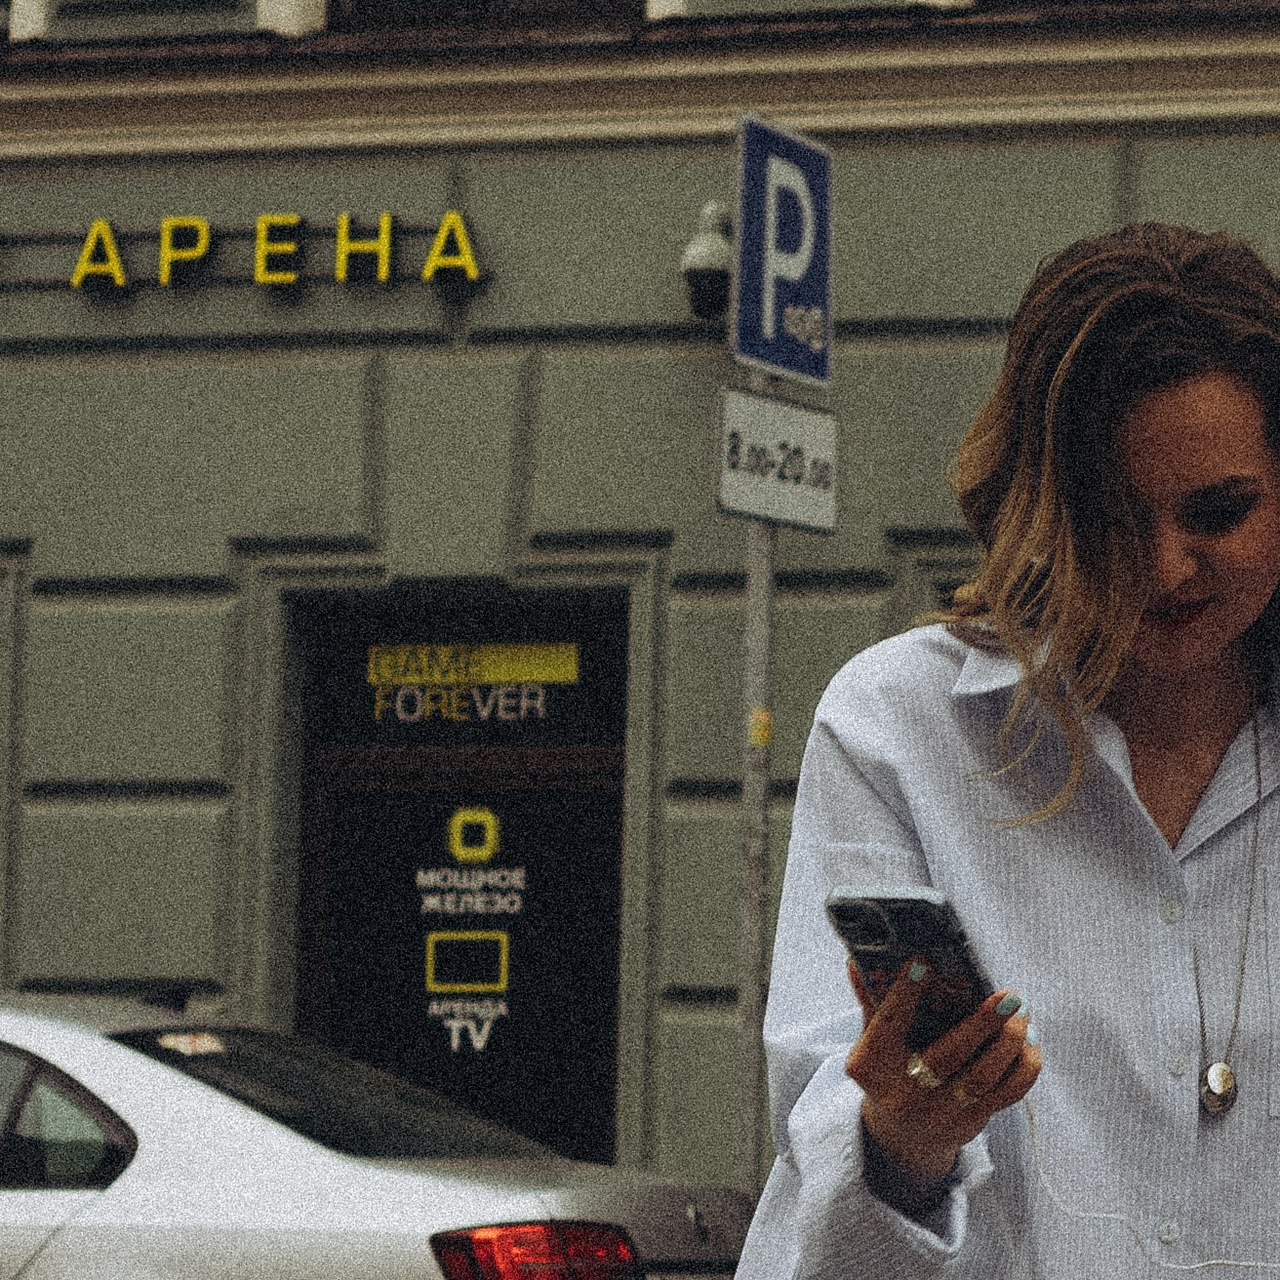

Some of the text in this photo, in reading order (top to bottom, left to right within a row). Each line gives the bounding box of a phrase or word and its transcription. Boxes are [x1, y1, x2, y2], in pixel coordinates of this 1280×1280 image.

[72, 211, 480, 287] АРЕНА
[763, 155, 817, 341] P
[373, 686, 547, 722] FOREVER
[443, 1020, 494, 1052] TV
